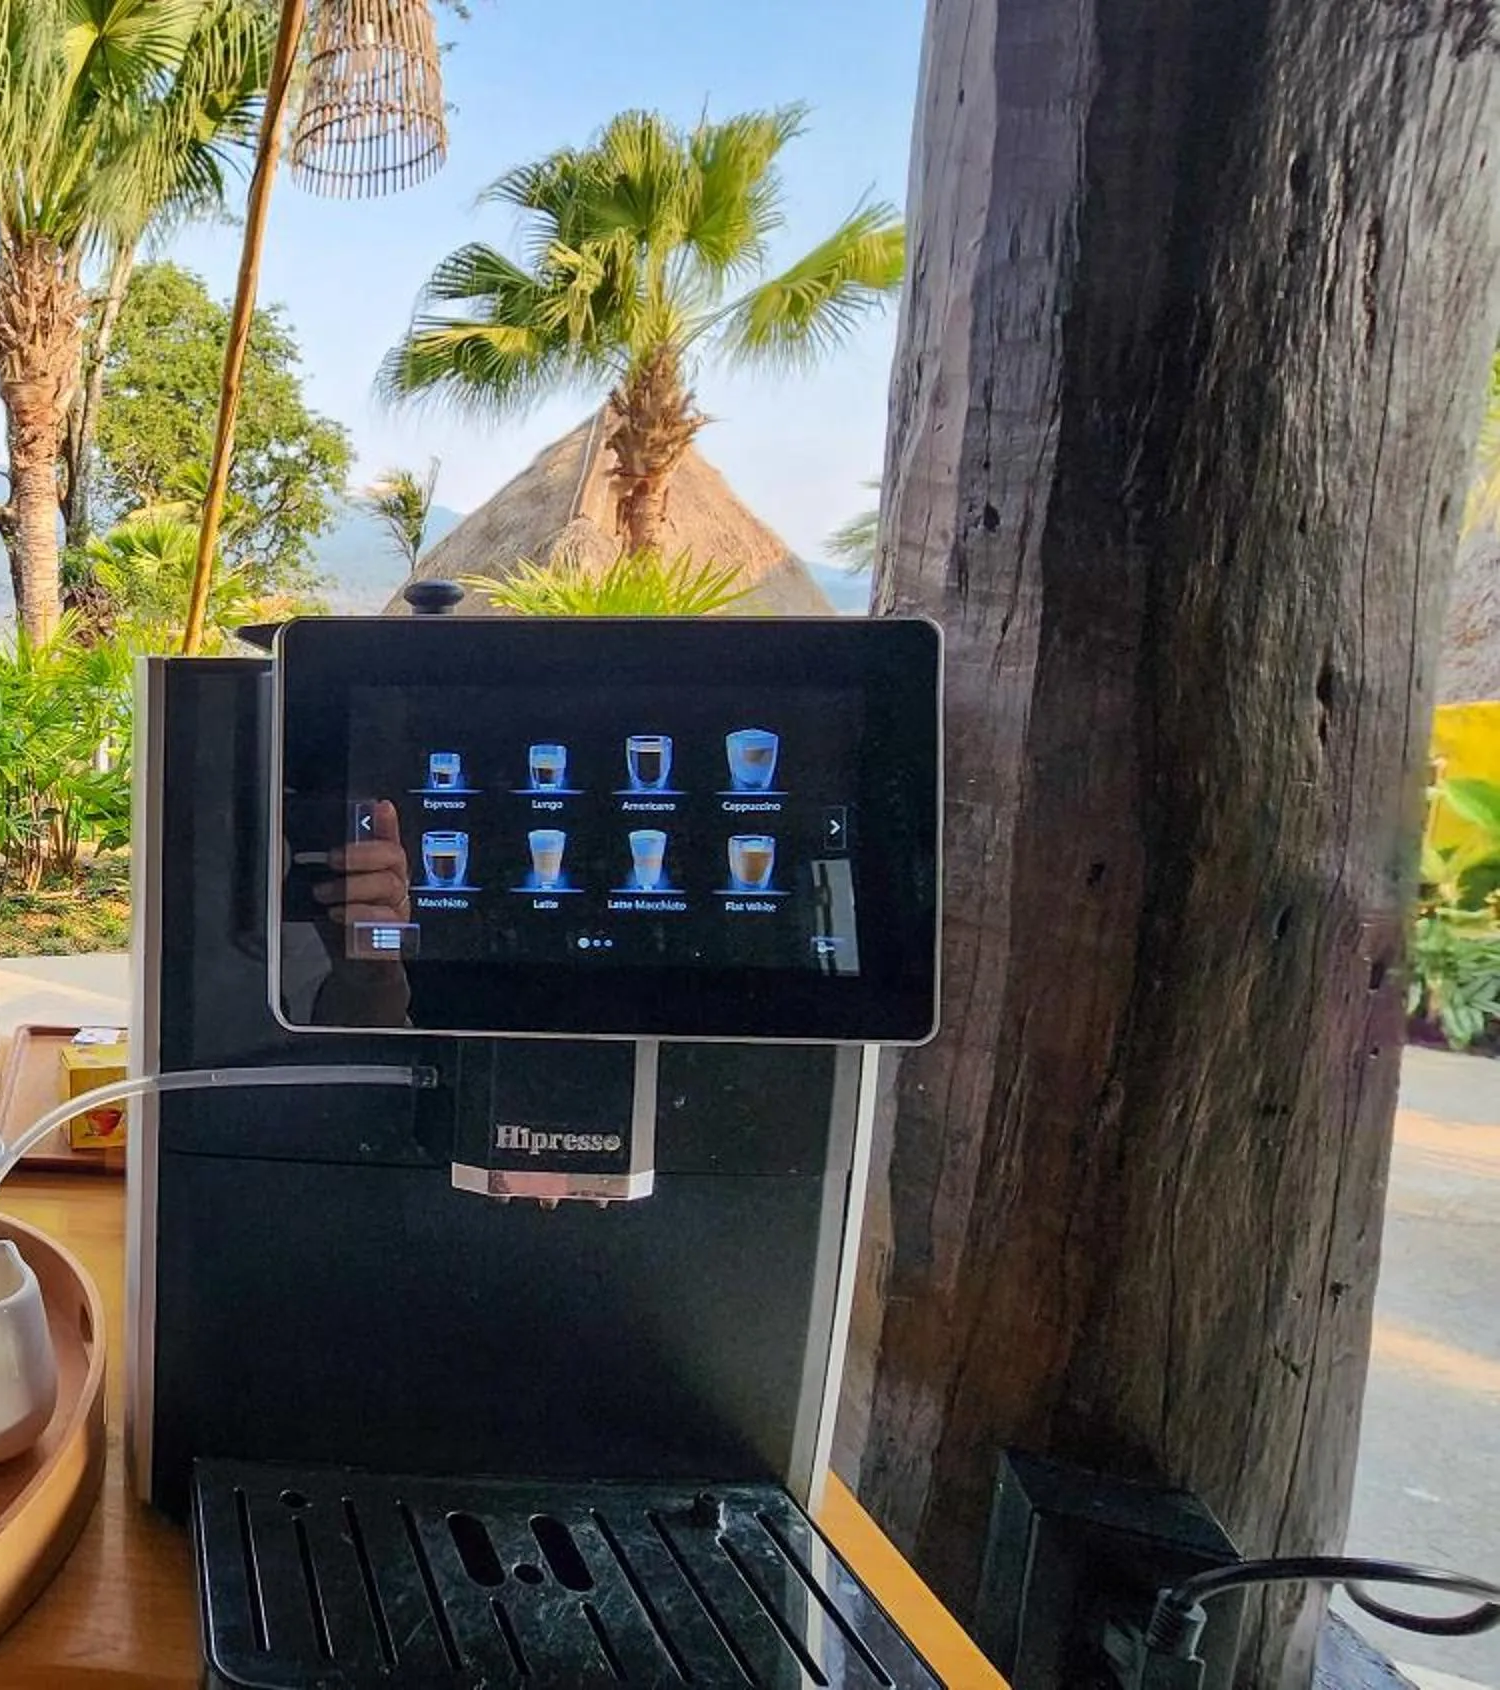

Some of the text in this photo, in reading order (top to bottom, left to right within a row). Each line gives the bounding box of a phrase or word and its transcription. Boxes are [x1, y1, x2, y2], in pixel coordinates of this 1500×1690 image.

[423, 799, 467, 810] Espresso
[531, 799, 564, 811] Lungo
[621, 801, 676, 811] Americano
[721, 801, 781, 813] Cappuccino
[417, 897, 469, 909] Macchiato
[533, 899, 559, 909] Latte
[607, 899, 687, 911] Latte Macchiato
[725, 901, 777, 912] Flat White
[495, 1123, 622, 1154] Hipresso
